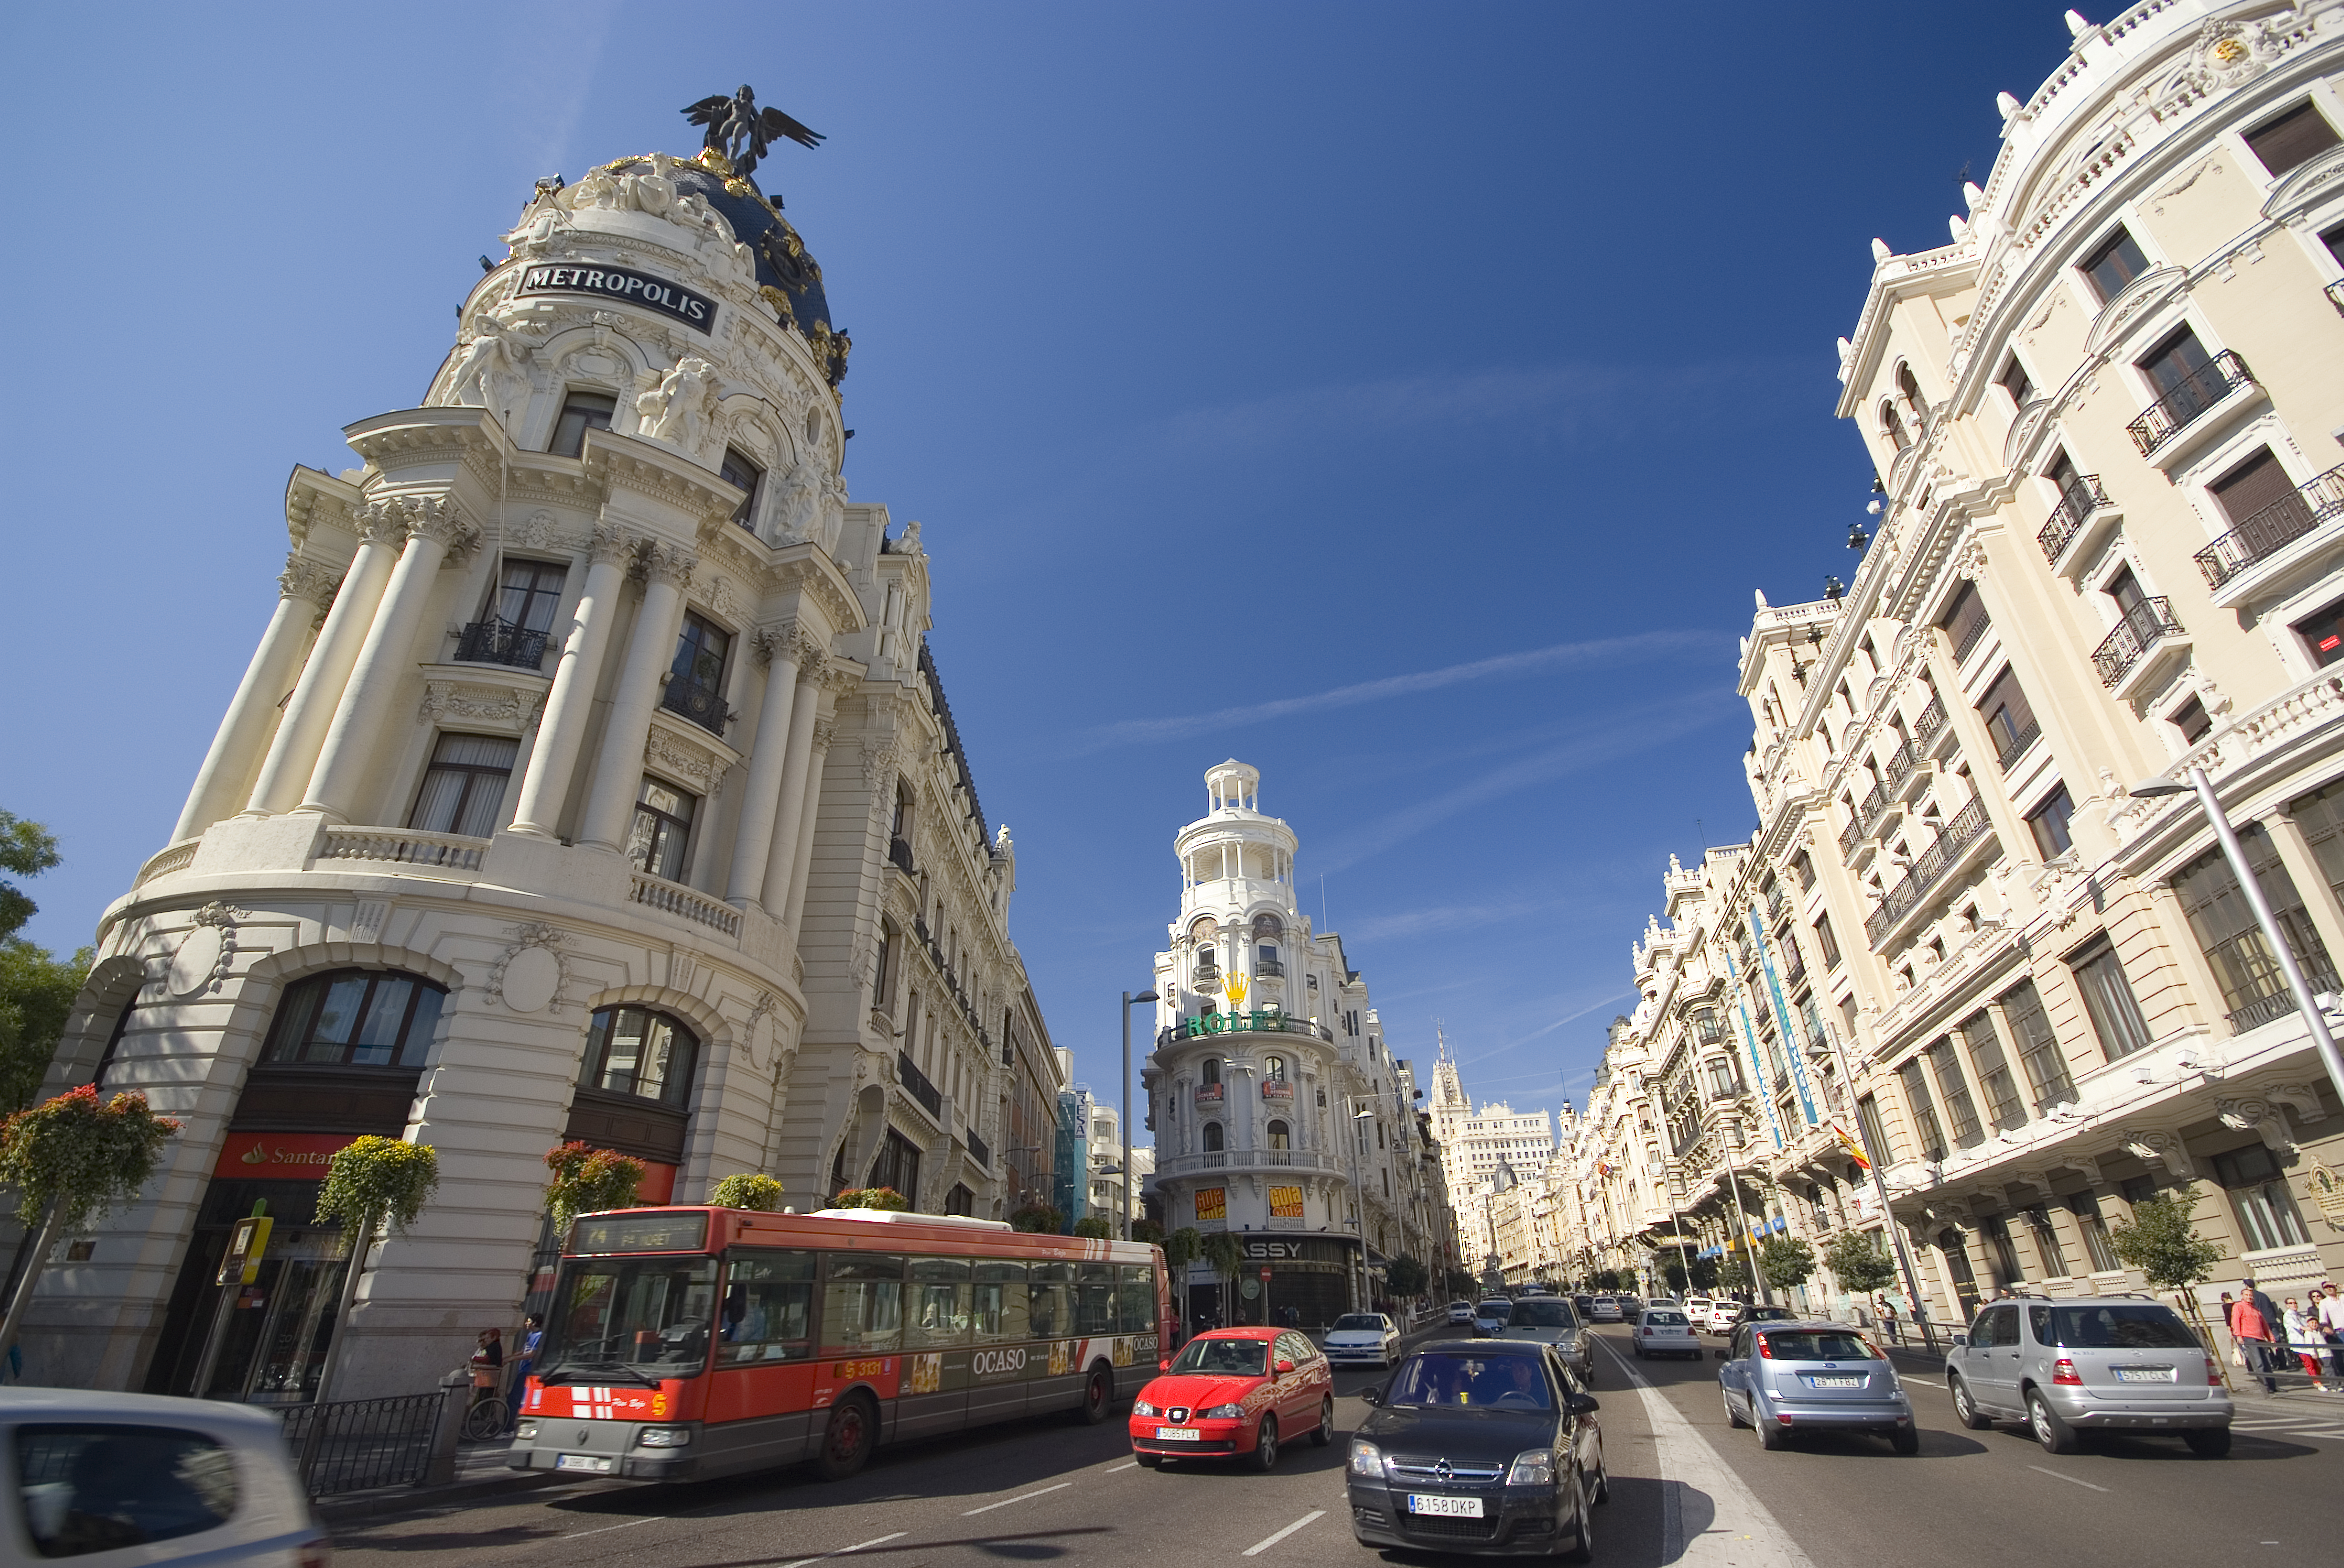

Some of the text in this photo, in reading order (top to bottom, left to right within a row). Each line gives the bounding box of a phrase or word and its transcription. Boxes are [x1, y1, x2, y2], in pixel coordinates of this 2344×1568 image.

[527, 269, 706, 320] METROPOLIS
[1185, 1011, 1291, 1036] ROLEX
[1076, 1095, 1085, 1134] RESA
[1133, 1336, 1158, 1351] OCASO
[858, 1361, 882, 1376] 3131
[973, 1348, 1026, 1374] OCASO
[1163, 1429, 1196, 1438] 5085 FLX
[1417, 1497, 1475, 1514] 6158 DKP
